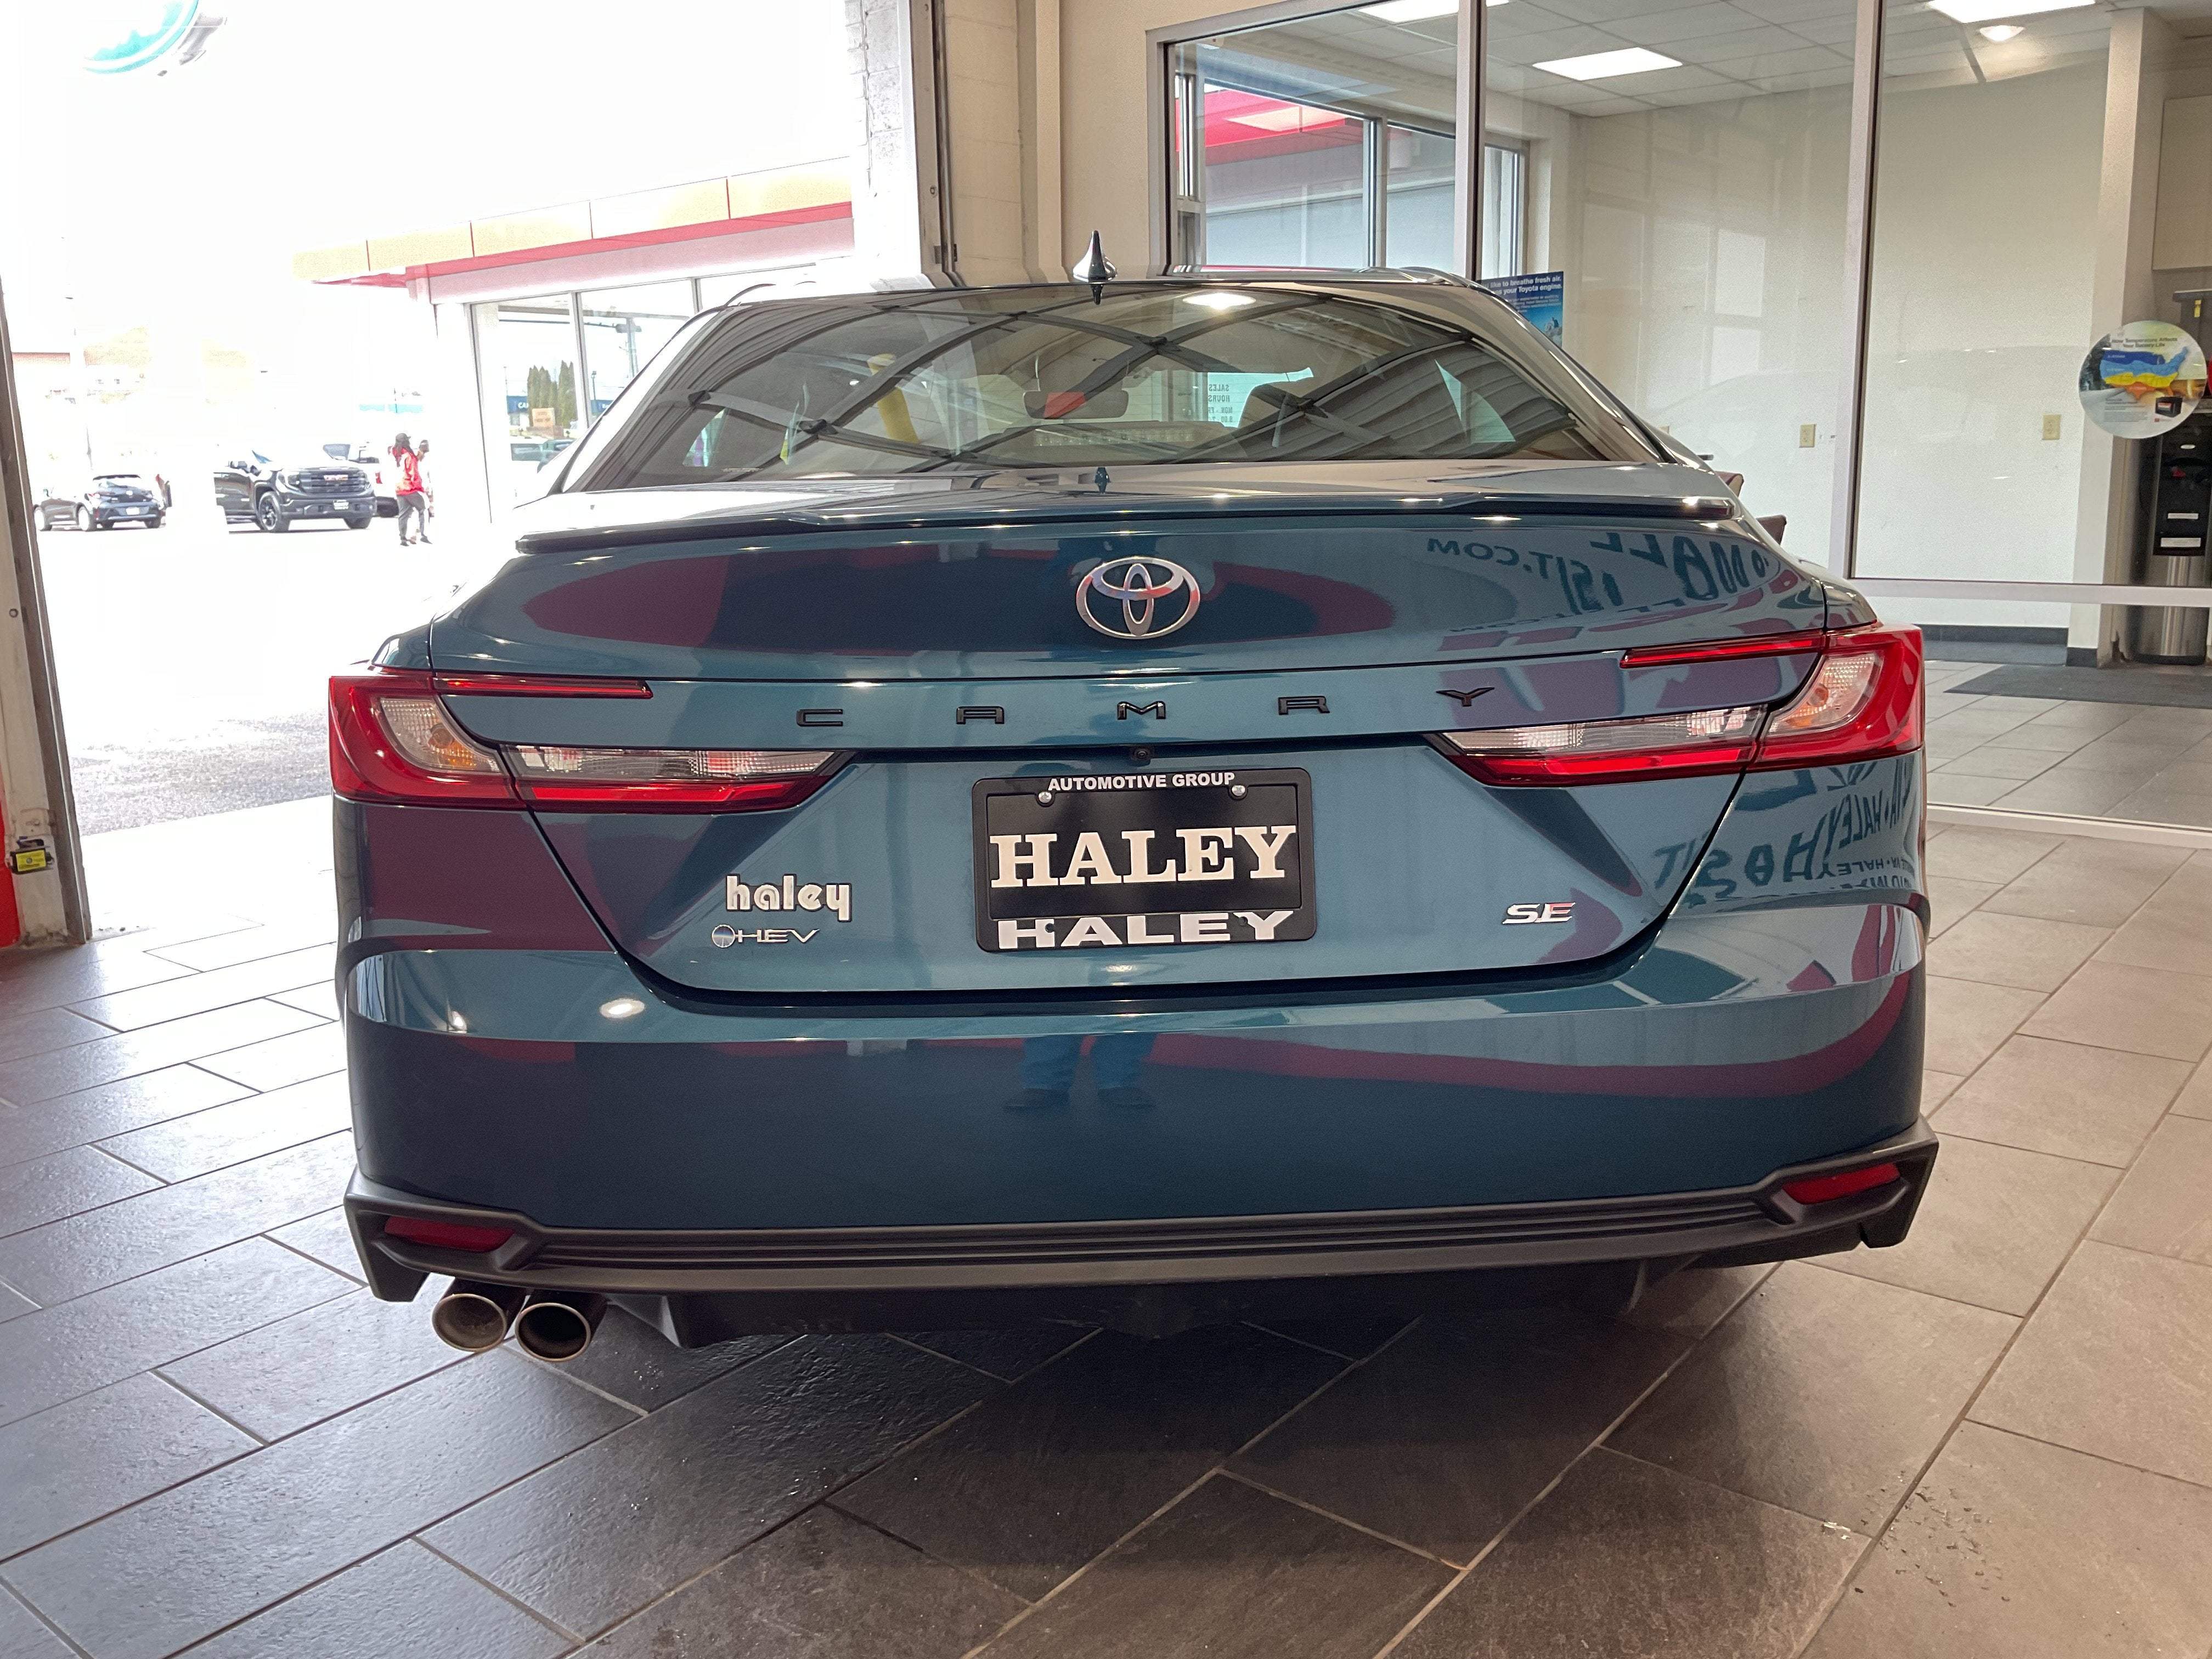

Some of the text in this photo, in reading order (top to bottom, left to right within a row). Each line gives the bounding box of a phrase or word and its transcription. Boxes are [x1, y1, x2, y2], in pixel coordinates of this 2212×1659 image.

[1518, 286, 1538, 294] Toyota
[1539, 284, 1562, 292] engine.
[795, 686, 1495, 727] CAMRY
[1047, 772, 1235, 791] AUTOMOTIVE GROUP
[989, 825, 1296, 888] HALEY
[726, 873, 852, 922] haley
[1502, 902, 1576, 924] SE
[738, 928, 820, 944] HEV
[997, 911, 1293, 949] HALEY
